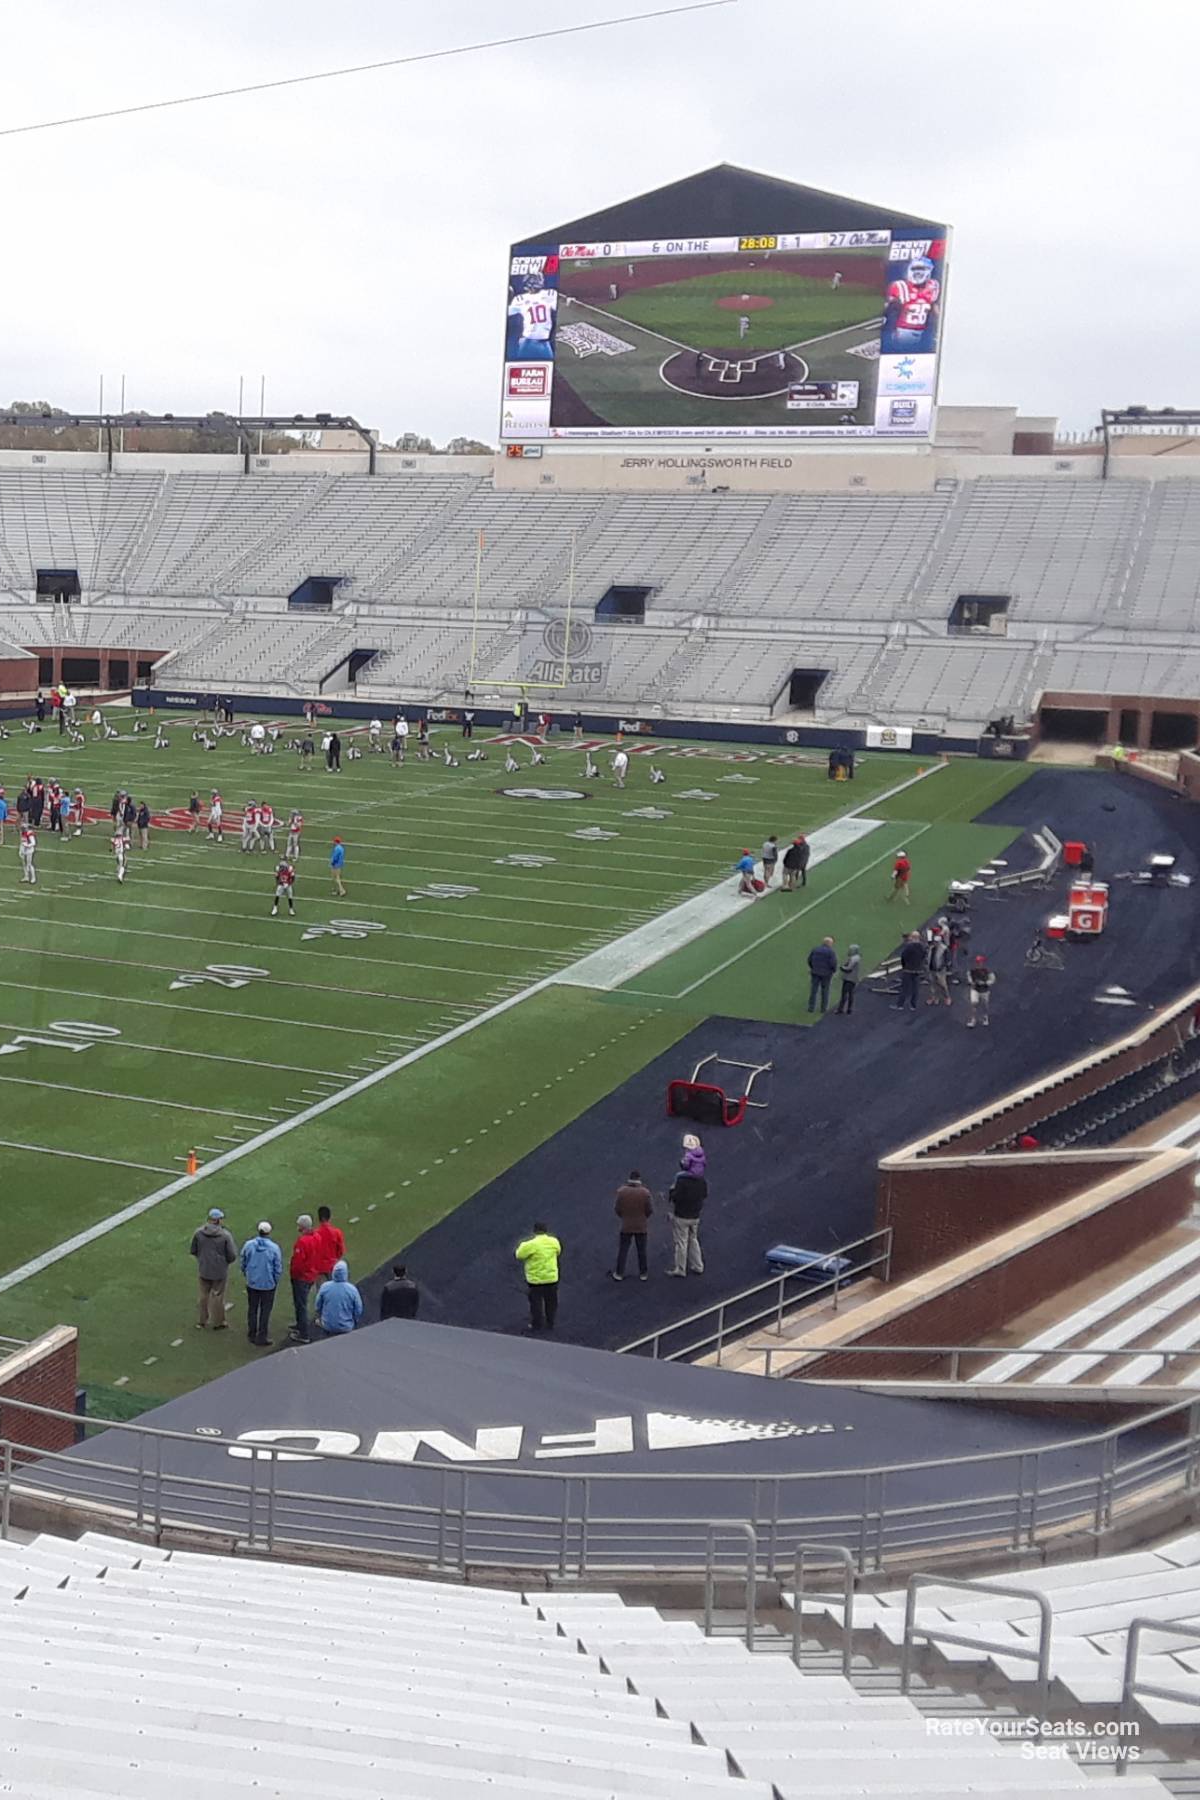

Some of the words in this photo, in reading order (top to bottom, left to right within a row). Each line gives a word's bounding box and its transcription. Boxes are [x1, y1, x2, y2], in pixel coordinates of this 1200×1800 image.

[666, 242, 683, 252] ON
[688, 240, 709, 251] THE
[740, 237, 776, 249] 28:08
[829, 234, 846, 246] 27
[603, 244, 611, 256] 0
[528, 304, 547, 324] 10
[521, 368, 545, 377] FARM
[510, 377, 544, 386] BUREAU
[508, 445, 522, 457] 25
[620, 457, 655, 468] JERRY
[658, 457, 757, 468] HOLLINGSWORTH
[760, 457, 793, 468] FIELD
[528, 660, 601, 682] Allstate
[166, 696, 197, 705] NISSAN
[426, 708, 461, 722] FedEx
[1078, 913, 1093, 929] G
[178, 964, 271, 989] 20
[11, 1021, 122, 1053] 10
[227, 1415, 635, 1462] FNC
